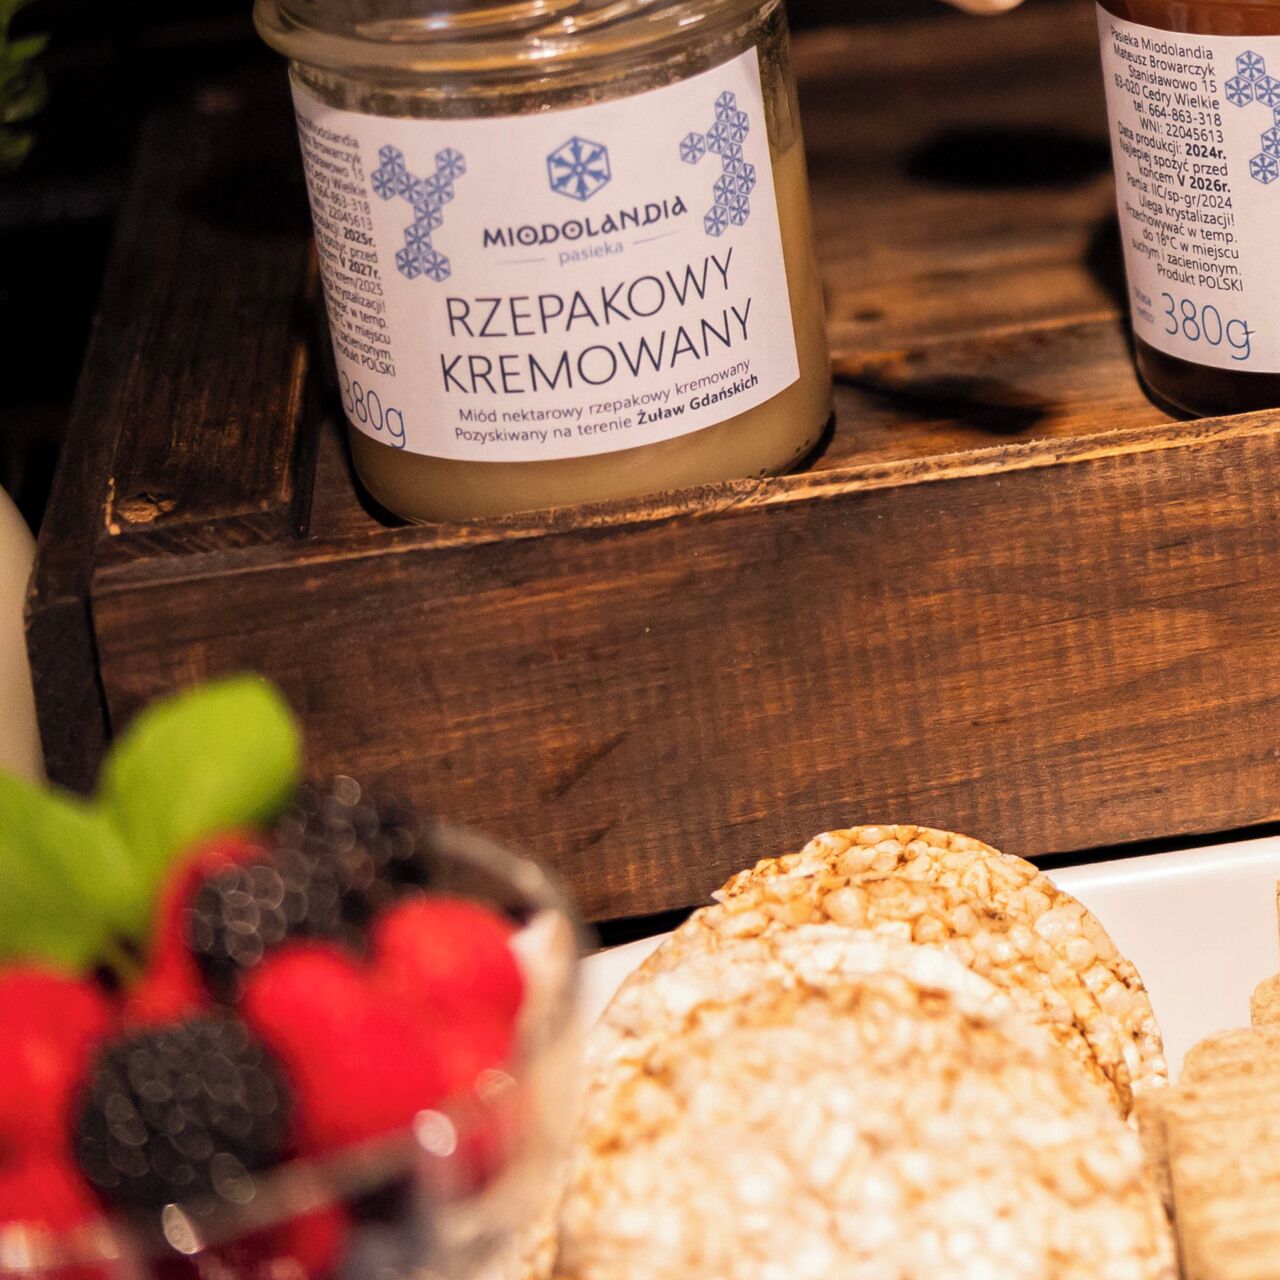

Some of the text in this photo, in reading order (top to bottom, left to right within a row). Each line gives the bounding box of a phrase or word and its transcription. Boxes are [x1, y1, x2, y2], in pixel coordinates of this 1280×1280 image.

[1110, 23, 1214, 60] Pasieka Miodolandia
[1113, 42, 1216, 80] Mateusz Browarczyk
[1128, 64, 1217, 94] Stanisławowo 15
[1142, 85, 1171, 108] Cedry
[1174, 92, 1220, 110] Wielkie
[1133, 98, 1222, 127] tel. 664-863-318
[1139, 116, 1224, 144] WNI: 22045613
[1135, 132, 1182, 157] produkcji:
[1184, 142, 1227, 160] 2024r.
[1153, 154, 1189, 174] spożyć
[1192, 162, 1229, 178] przed
[1177, 173, 1186, 187] V
[1189, 175, 1231, 194] 2026r.
[483, 196, 688, 248] MIODOLANDIA
[1139, 194, 1235, 229] Ulega krystalizacji!
[342, 226, 377, 249] 2025r.
[1142, 227, 1154, 241] do
[1180, 241, 1189, 252] w
[1192, 242, 1240, 261] miejscu
[1187, 227, 1197, 238] w
[1200, 228, 1238, 245] temp.
[350, 248, 379, 265] przed
[558, 239, 625, 267] pasieka
[1167, 253, 1242, 278] zacienionym.
[348, 259, 383, 280] 2027r.
[1157, 262, 1244, 292] Produkt POLSKI
[446, 247, 733, 338] RZEPAKOWY
[356, 324, 393, 345] miejscu
[361, 310, 391, 331] temp.
[1161, 292, 1251, 361] 380g
[440, 297, 752, 395] KREMOWANY
[361, 354, 398, 378] POLSKI
[458, 357, 751, 424] Miód nektarowy rzepakowy kremowany
[341, 371, 406, 449] 380g
[454, 373, 760, 445] Pozyskiwany na terenie Żuław Gdańskich
